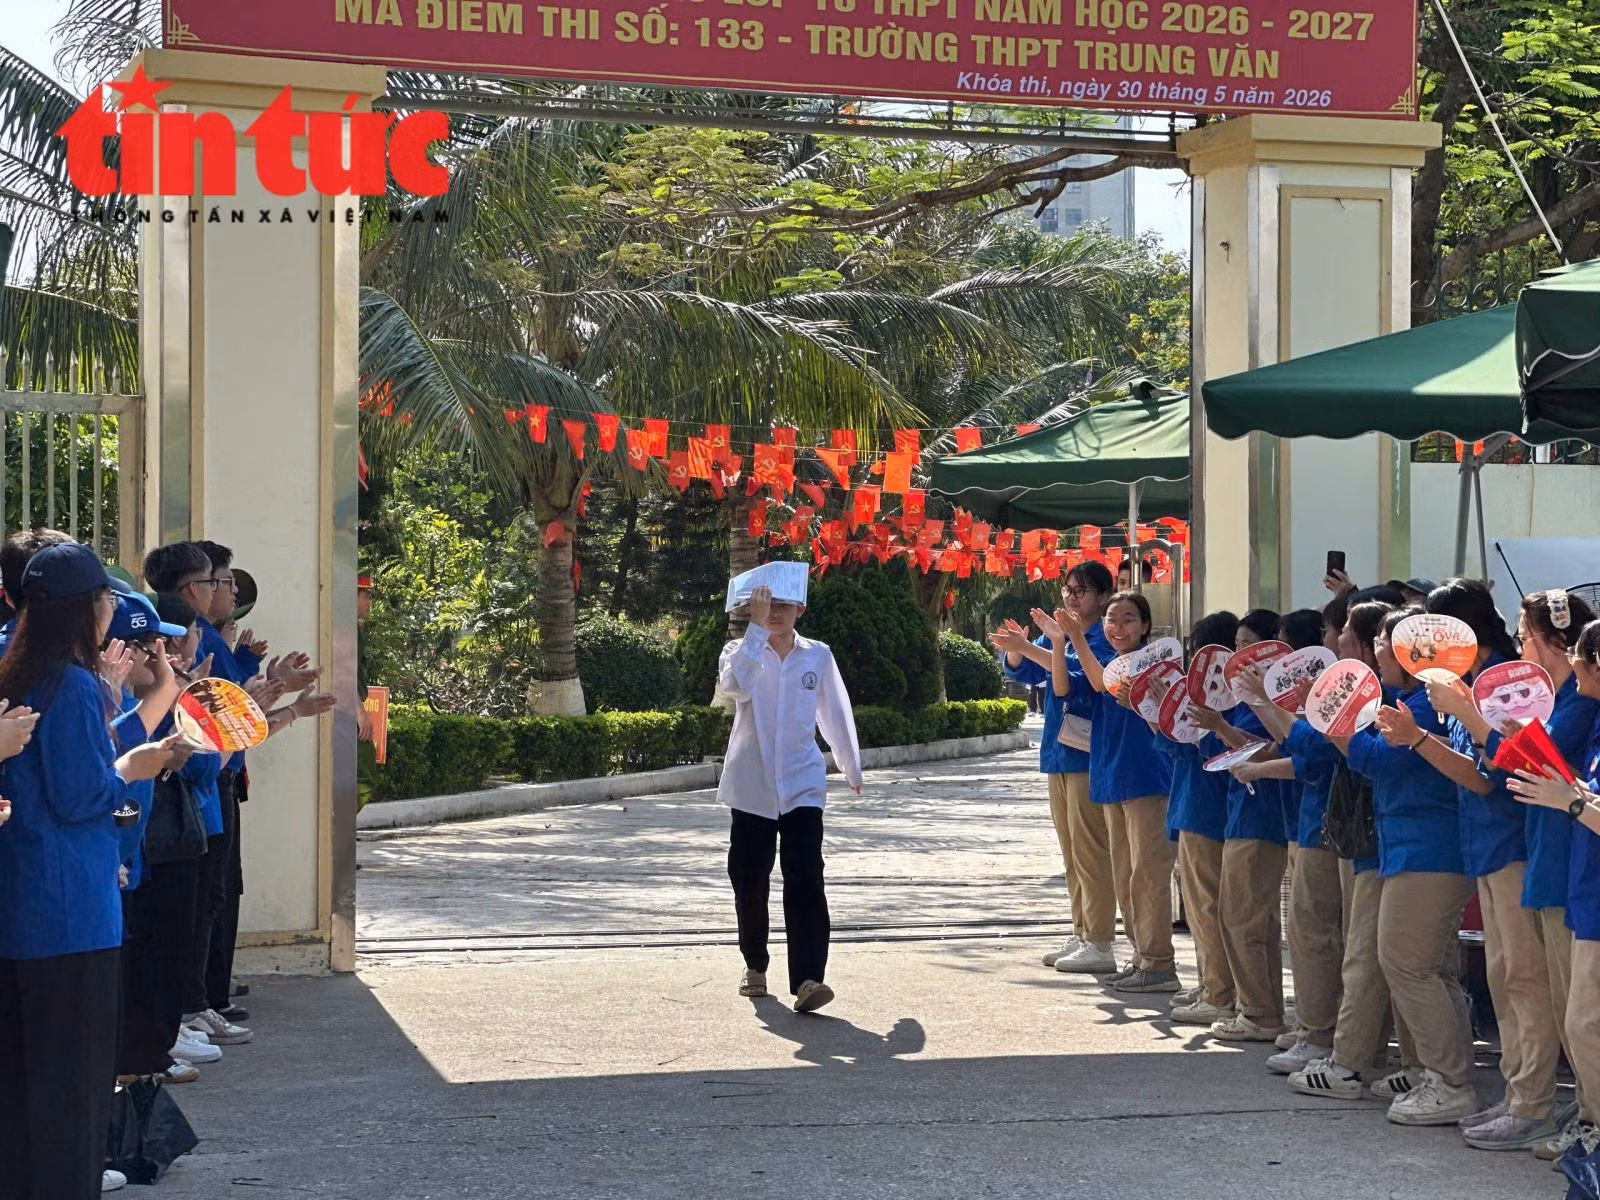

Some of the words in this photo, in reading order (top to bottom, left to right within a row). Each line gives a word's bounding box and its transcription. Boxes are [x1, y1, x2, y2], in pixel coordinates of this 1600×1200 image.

[1074, 0, 1149, 35] HỌC
[1161, 2, 1249, 36] 2026
[1261, 20, 1274, 28] -
[1287, 9, 1374, 41] 2027
[536, 5, 600, 40] THI
[614, 3, 679, 46] SỐ:
[694, 17, 764, 51] 133
[804, 22, 958, 63] TRƯỜNG
[970, 34, 1063, 68] THPT
[1073, 39, 1195, 75] TRUNG
[1207, 42, 1280, 79] VĂN
[956, 71, 1012, 93] Khóa
[1019, 75, 1052, 97] thi,
[1059, 80, 1112, 101] ngày
[1117, 80, 1143, 99] 30
[1148, 81, 1208, 106] tháng
[1213, 85, 1227, 103] 5
[1232, 85, 1276, 105] năm
[1282, 88, 1333, 107] 2026
[131, 616, 148, 629] 5G
